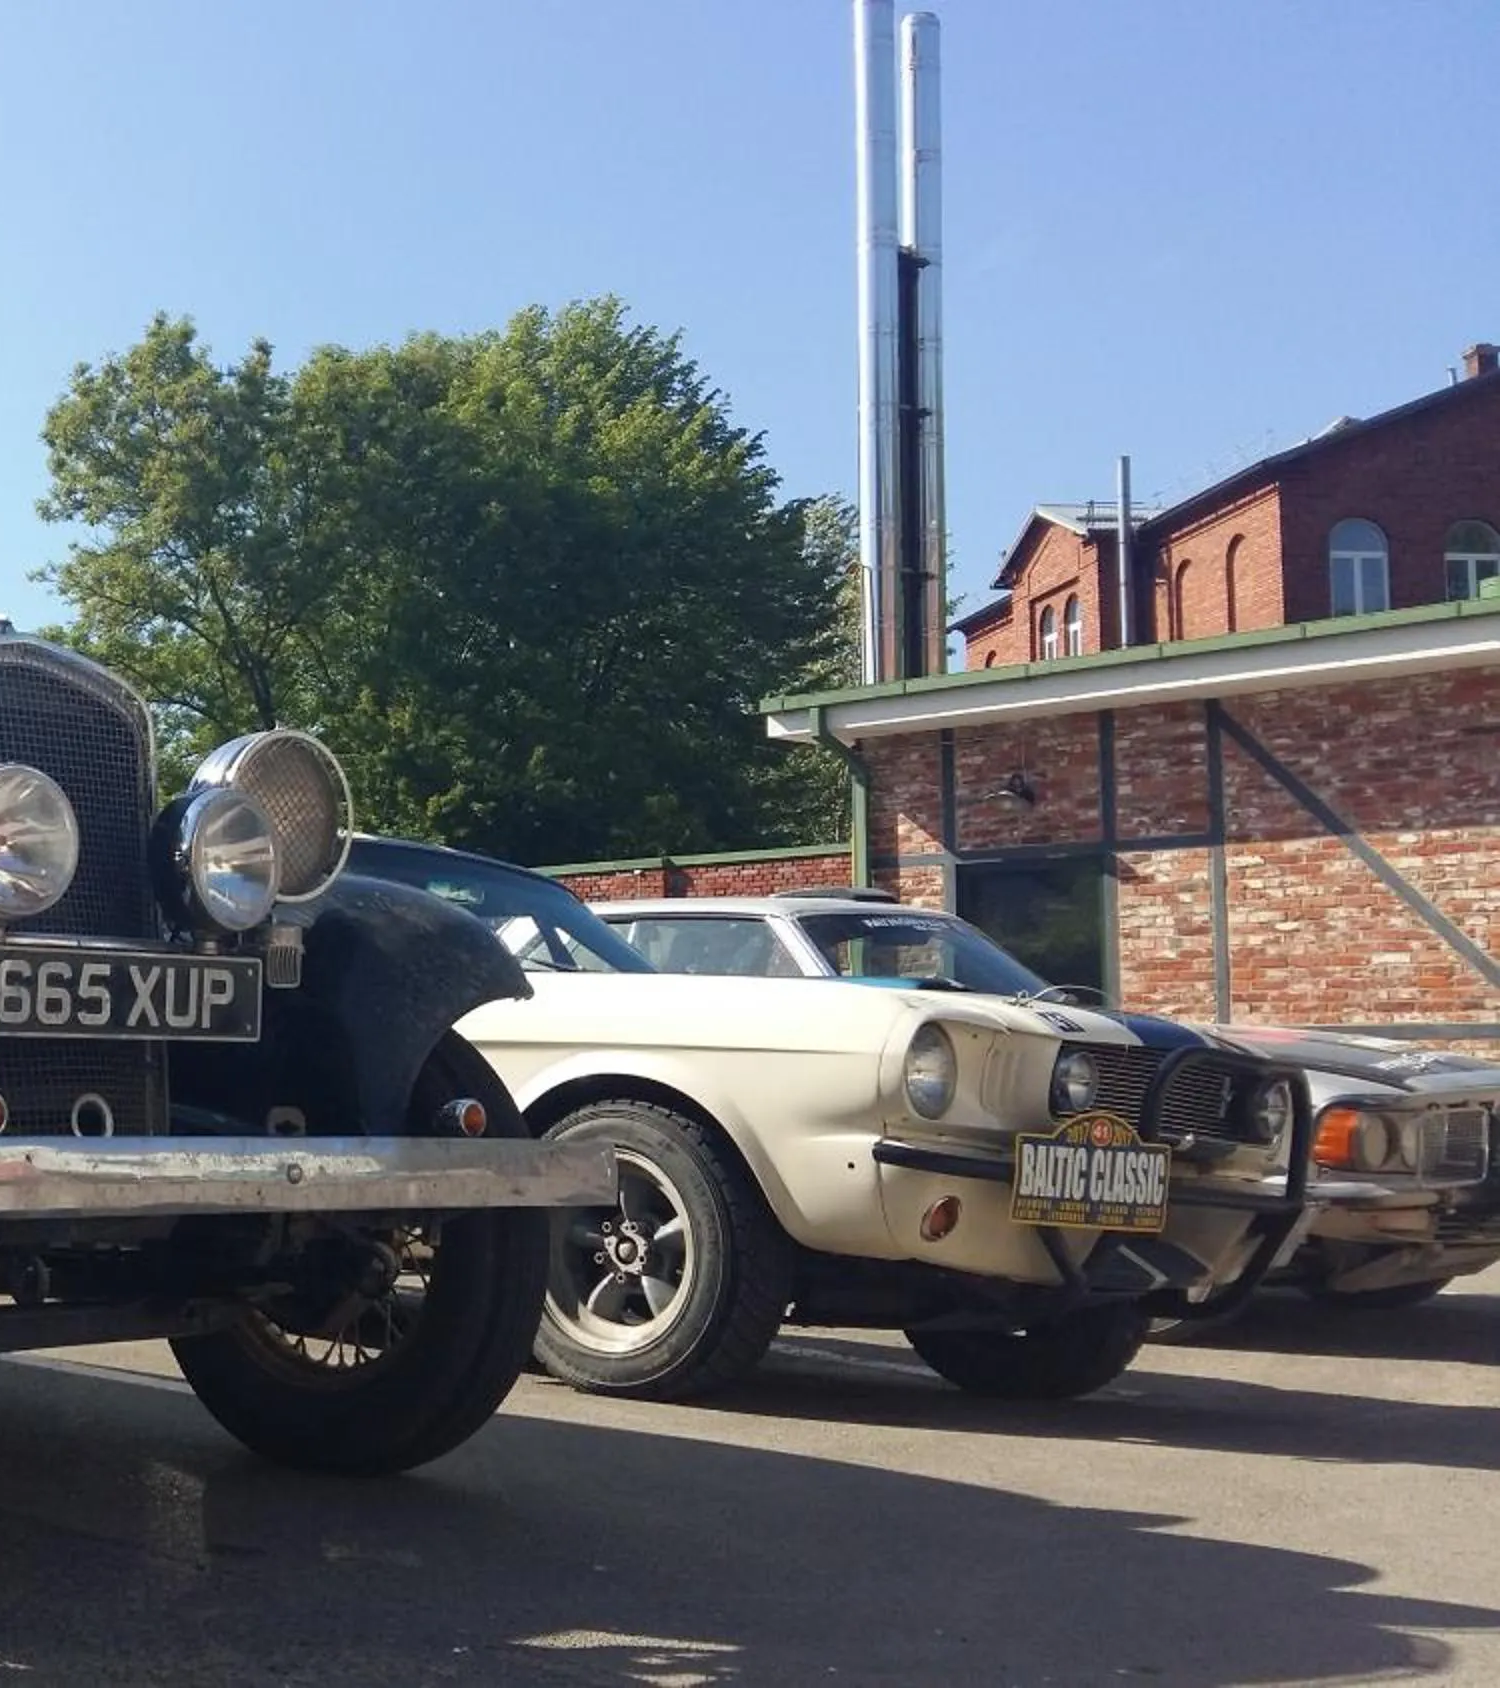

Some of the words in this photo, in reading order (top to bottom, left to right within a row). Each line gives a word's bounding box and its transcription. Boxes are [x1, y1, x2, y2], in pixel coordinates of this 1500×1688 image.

[126, 965, 235, 1029] XUP
[1019, 1143, 1088, 1200] BALTIC
[1089, 1149, 1166, 1205] CLASSIC
